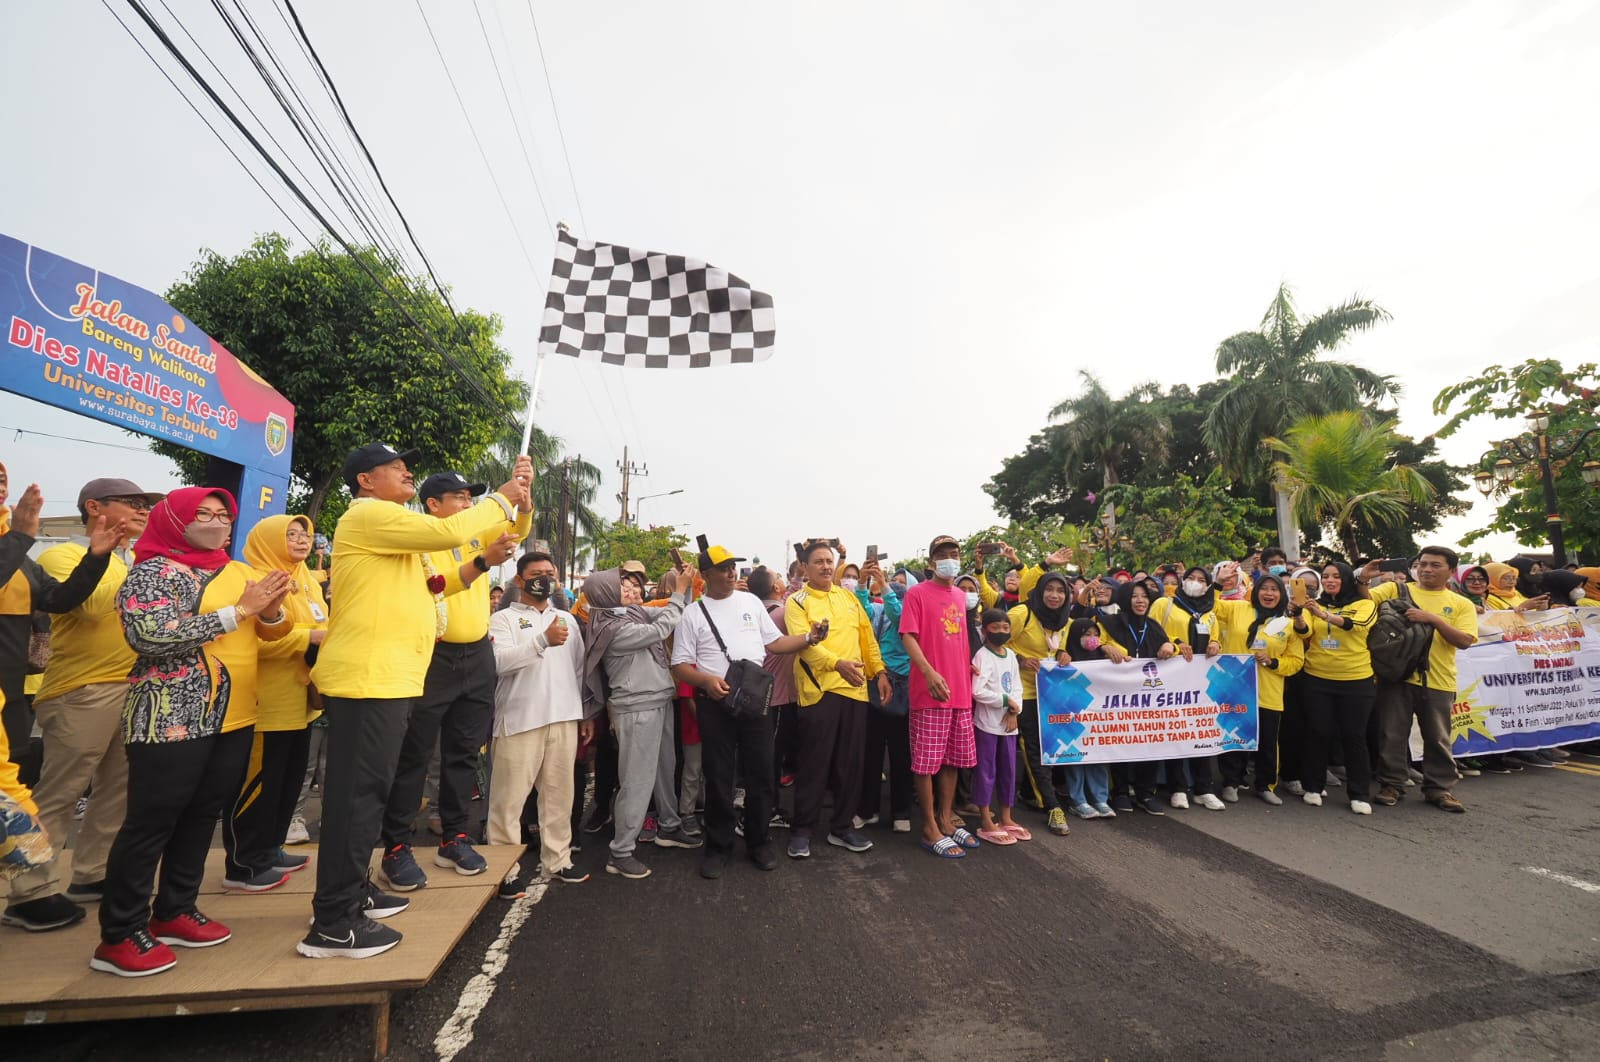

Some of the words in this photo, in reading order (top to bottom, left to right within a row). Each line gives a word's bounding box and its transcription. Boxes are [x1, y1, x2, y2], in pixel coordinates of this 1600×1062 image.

[71, 283, 149, 340] Jalan
[152, 323, 216, 374] Santai
[82, 317, 143, 361] Bareng
[148, 348, 206, 388] Walikota
[8, 315, 80, 366] Dies
[85, 347, 182, 407] Natalies
[186, 391, 238, 429] Ke-38
[44, 362, 155, 416] Universitas
[160, 406, 218, 440] Terbuka
[79, 397, 194, 442] www.surabaya.ut.ac.id
[1483, 671, 1554, 687] UNIVERSITAS
[1048, 714, 1072, 724] DIES
[1074, 711, 1115, 723] NATALIS
[1117, 708, 1179, 721] UNIVERSITAS
[1181, 705, 1218, 717] TERBUKA
[1102, 693, 1151, 709] JALAN
[1156, 690, 1200, 707] SEHAT
[1082, 736, 1096, 746] UT
[1098, 733, 1164, 745] BERKUALITAS
[1167, 730, 1196, 742] TANPA
[1198, 728, 1221, 739] BATAS
[1090, 723, 1130, 733] ALUMNI
[1132, 721, 1166, 732] TAHUN
[1168, 719, 1187, 730] 2011
